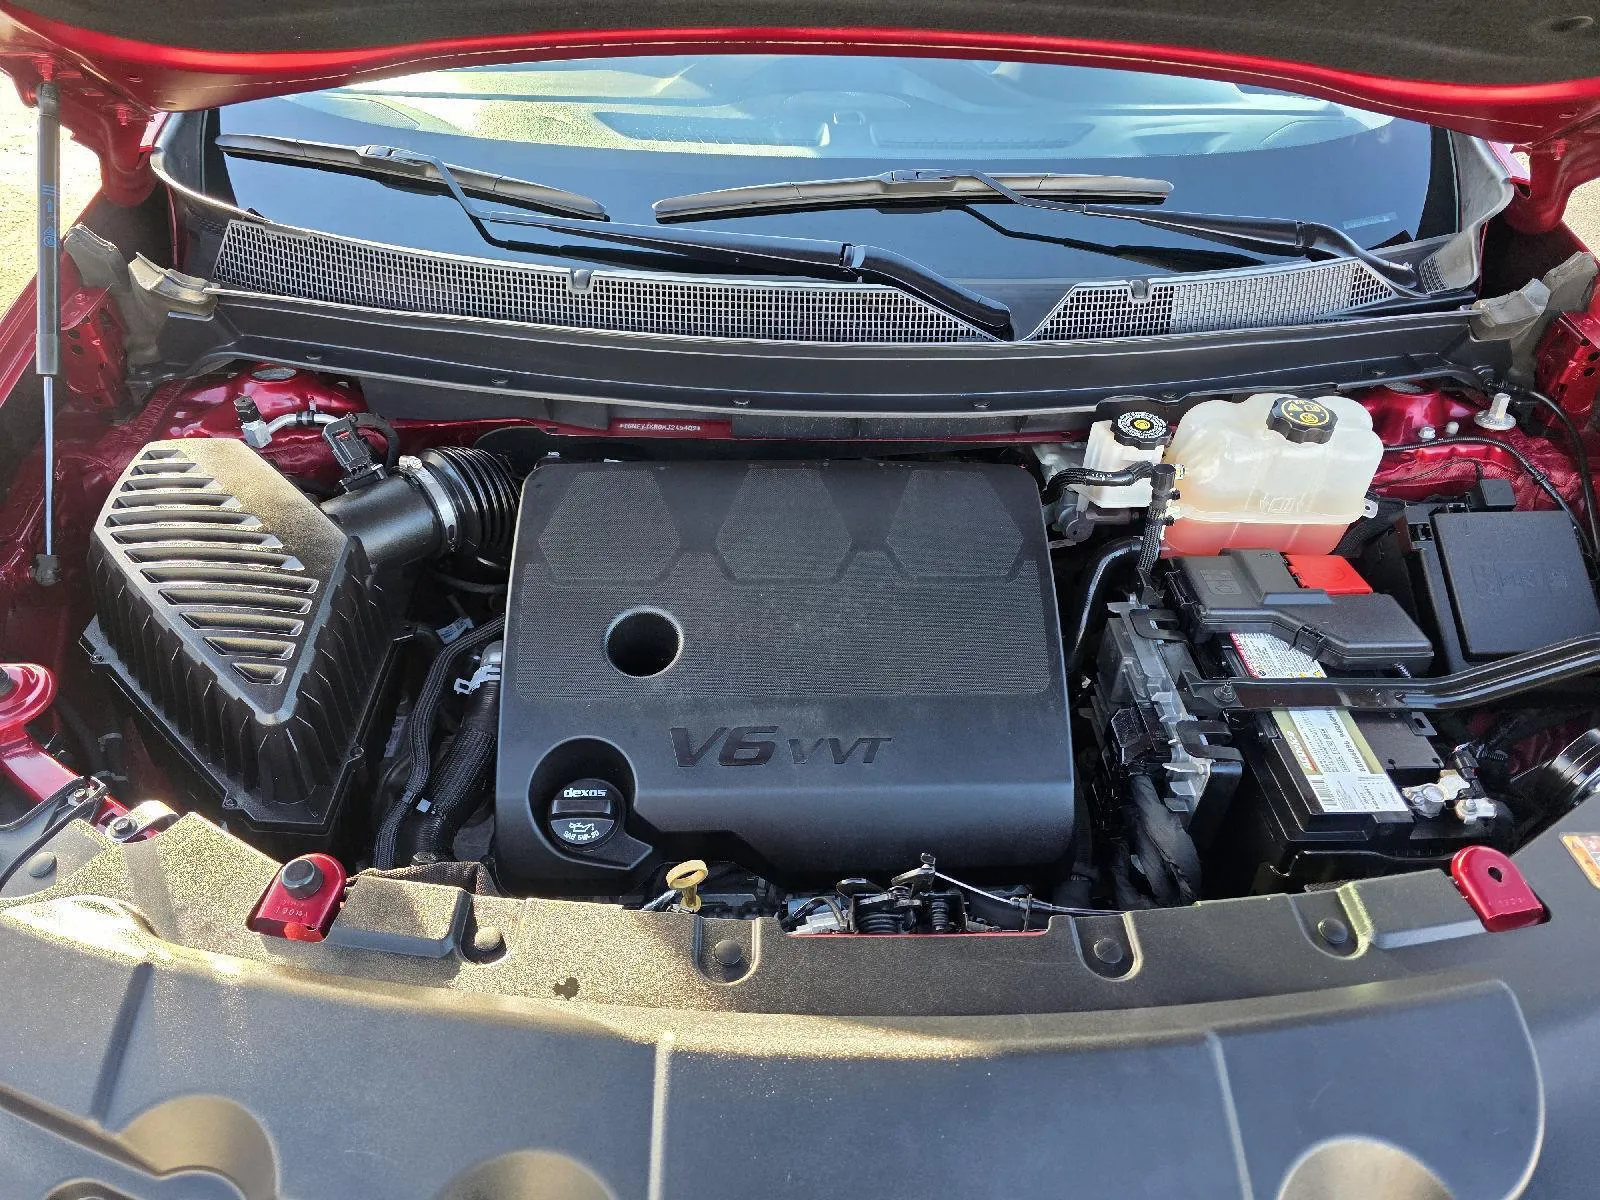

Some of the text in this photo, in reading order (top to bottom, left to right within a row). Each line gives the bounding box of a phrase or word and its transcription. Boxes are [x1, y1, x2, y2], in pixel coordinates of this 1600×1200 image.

[670, 725, 892, 767] V6 VVT
[563, 788, 607, 798] dexos
[563, 830, 577, 841] SAE
